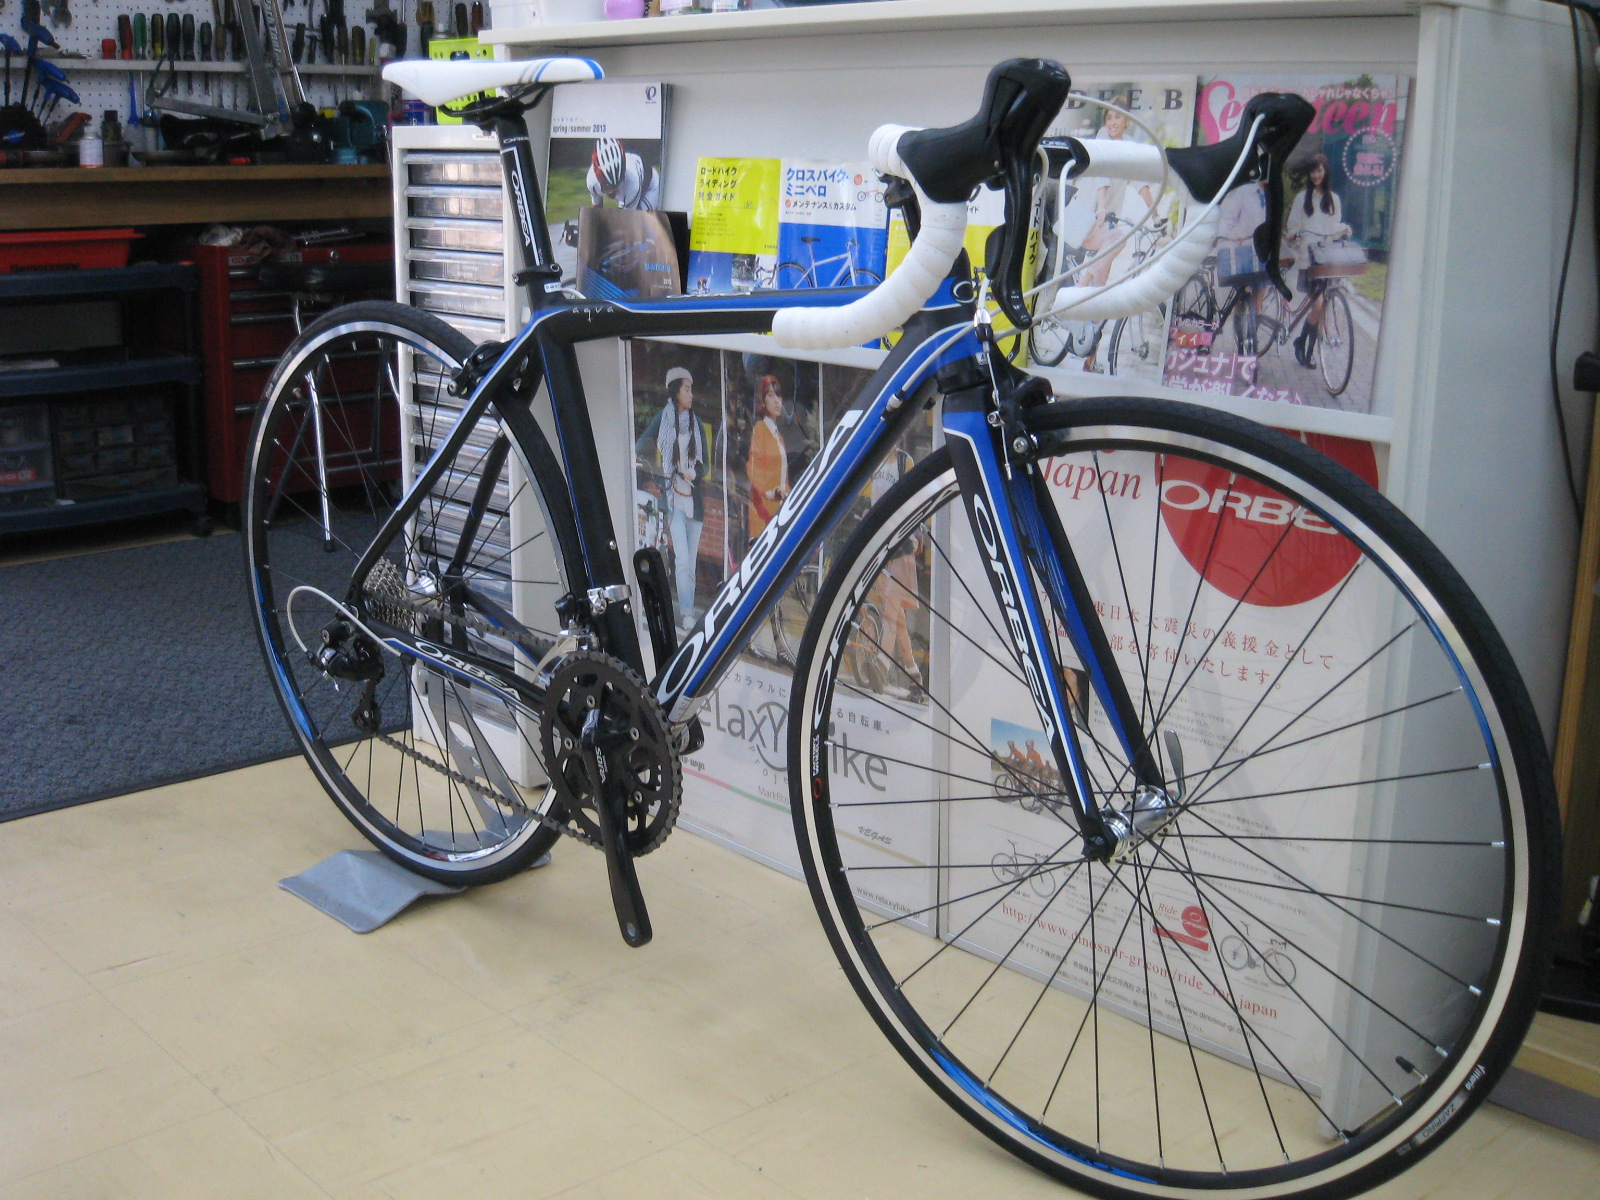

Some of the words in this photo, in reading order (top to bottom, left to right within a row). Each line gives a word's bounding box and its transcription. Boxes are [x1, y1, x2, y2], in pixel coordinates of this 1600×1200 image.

[1197, 81, 1397, 146] Seteen
[593, 124, 607, 132] 2013
[700, 166, 737, 176] ロードバイク
[699, 179, 737, 189] ライディング
[785, 183, 827, 197] ミニベロ
[511, 170, 531, 247] ORBEA
[792, 200, 857, 211] メンテナンス&カスタム
[656, 410, 863, 705] ORBEA
[973, 493, 1055, 746] ORBEA
[415, 641, 522, 702] ORBEA
[858, 826, 892, 845] VEGAS
[1158, 903, 1178, 915] Ride
